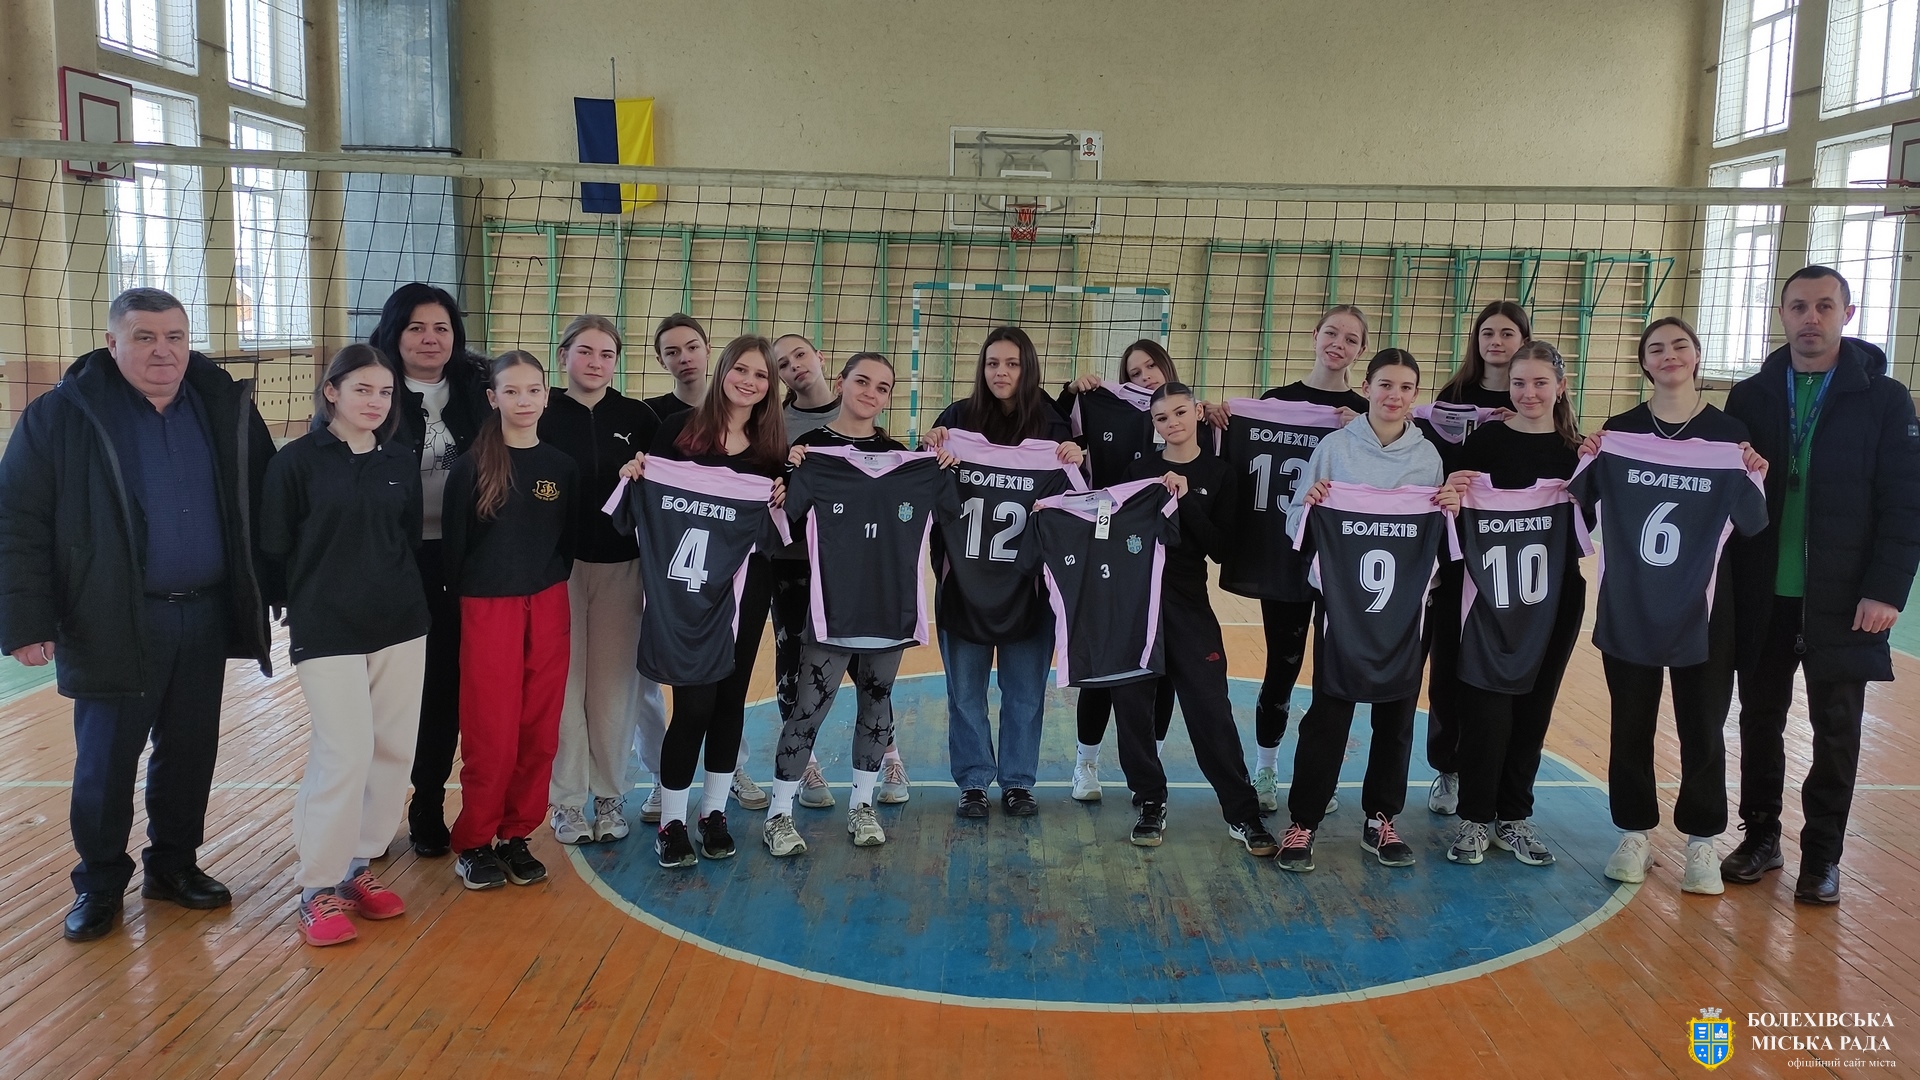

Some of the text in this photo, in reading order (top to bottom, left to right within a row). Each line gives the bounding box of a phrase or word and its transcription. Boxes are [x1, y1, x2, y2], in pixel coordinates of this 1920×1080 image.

[1249, 427, 1319, 448] БОЛЕХІВ
[960, 469, 1034, 491] БОЛЕХІВ
[1249, 453, 1310, 514] 13
[1627, 469, 1712, 494] БОЛЕХІВ
[661, 496, 736, 522] БОЛЕХІВ
[864, 522, 878, 539] 11
[960, 497, 1027, 562] 12
[1342, 521, 1418, 538] БОЛЕХІВ
[1478, 516, 1553, 535] БОЛЕХІВ
[1639, 502, 1681, 567] 6
[667, 527, 710, 592] 4
[1100, 563, 1110, 579] 3
[1359, 549, 1396, 613] 9
[1482, 543, 1549, 609] 10
